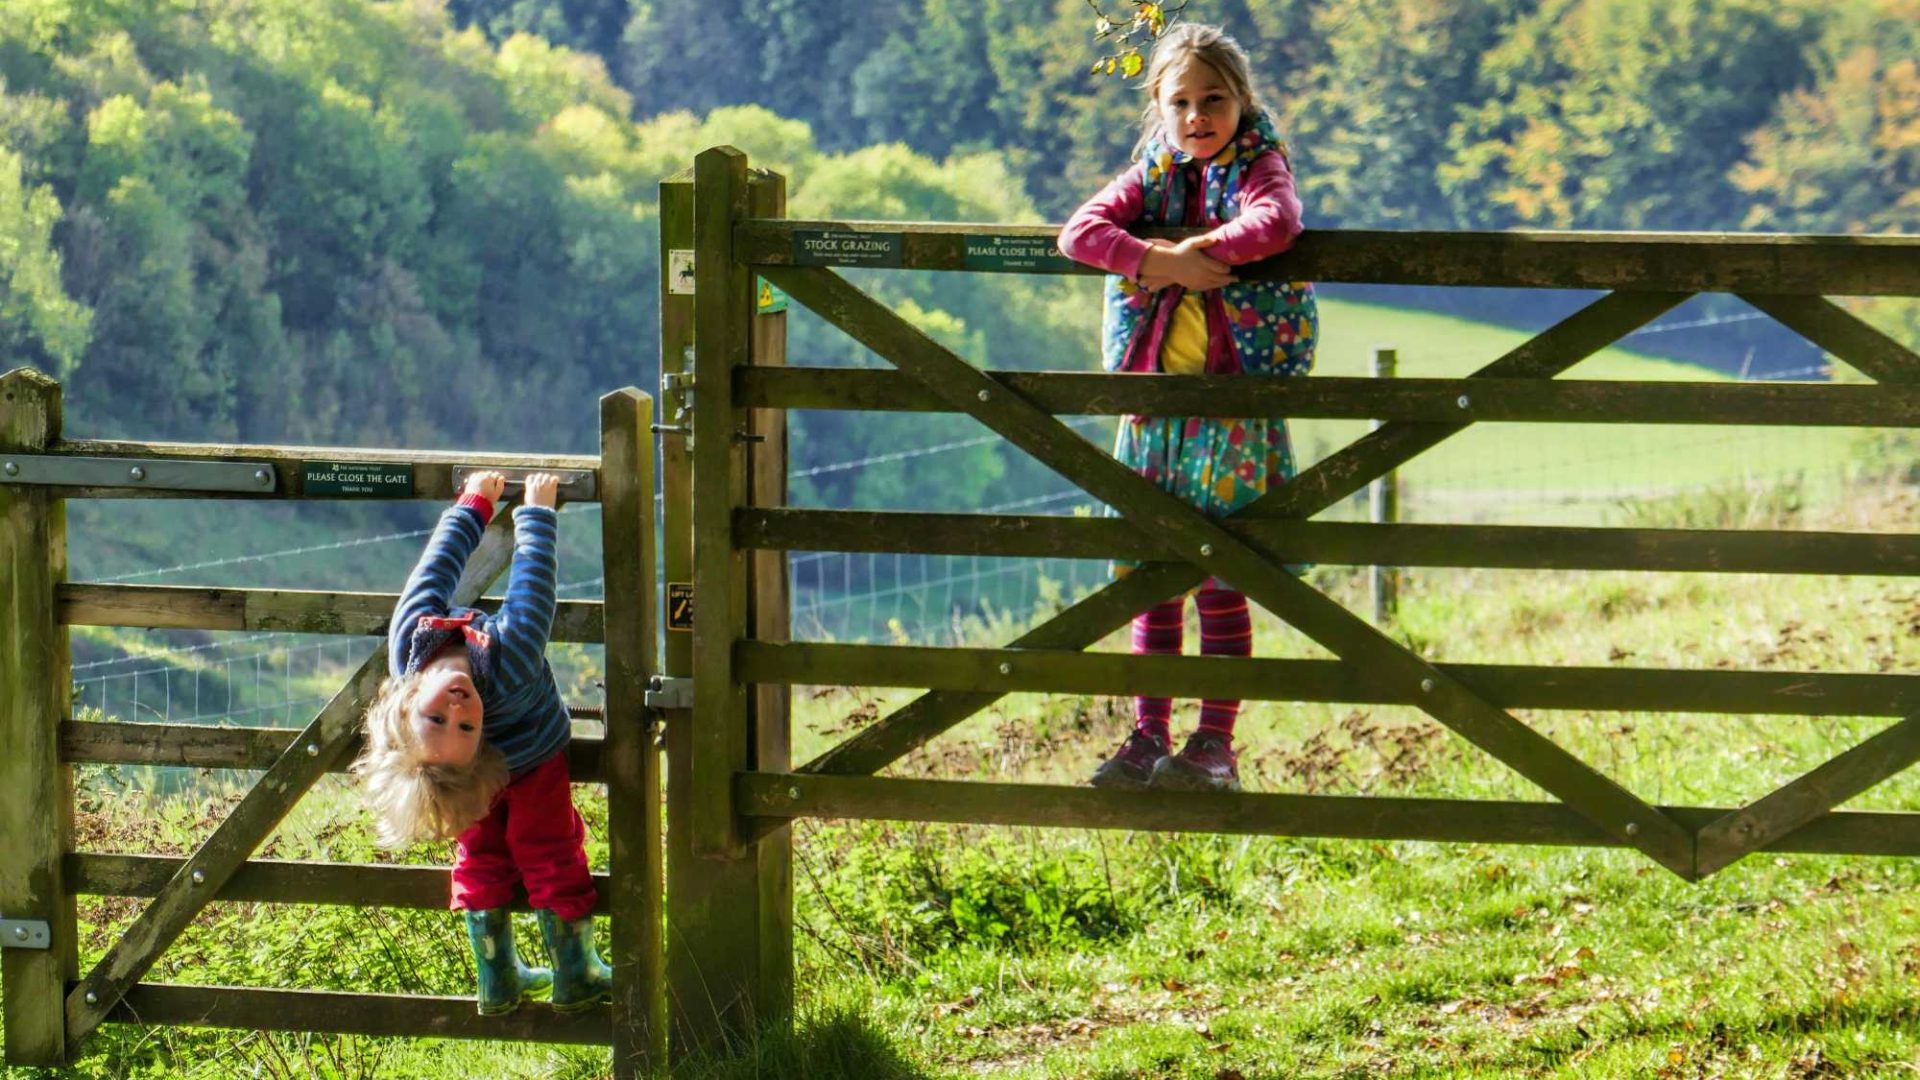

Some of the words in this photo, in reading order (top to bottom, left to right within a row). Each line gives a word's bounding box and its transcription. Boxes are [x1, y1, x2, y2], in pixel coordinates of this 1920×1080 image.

[804, 240, 838, 250] STOCK
[841, 240, 891, 252] GRAZING
[967, 246, 998, 256] PLEASE
[999, 247, 1027, 257] CLOSE
[1029, 247, 1045, 257] THE
[1047, 248, 1065, 257] GA
[307, 472, 336, 482] PLEASE
[338, 473, 365, 483] CLOSE
[366, 474, 383, 484] THE
[384, 475, 408, 485] GATE
